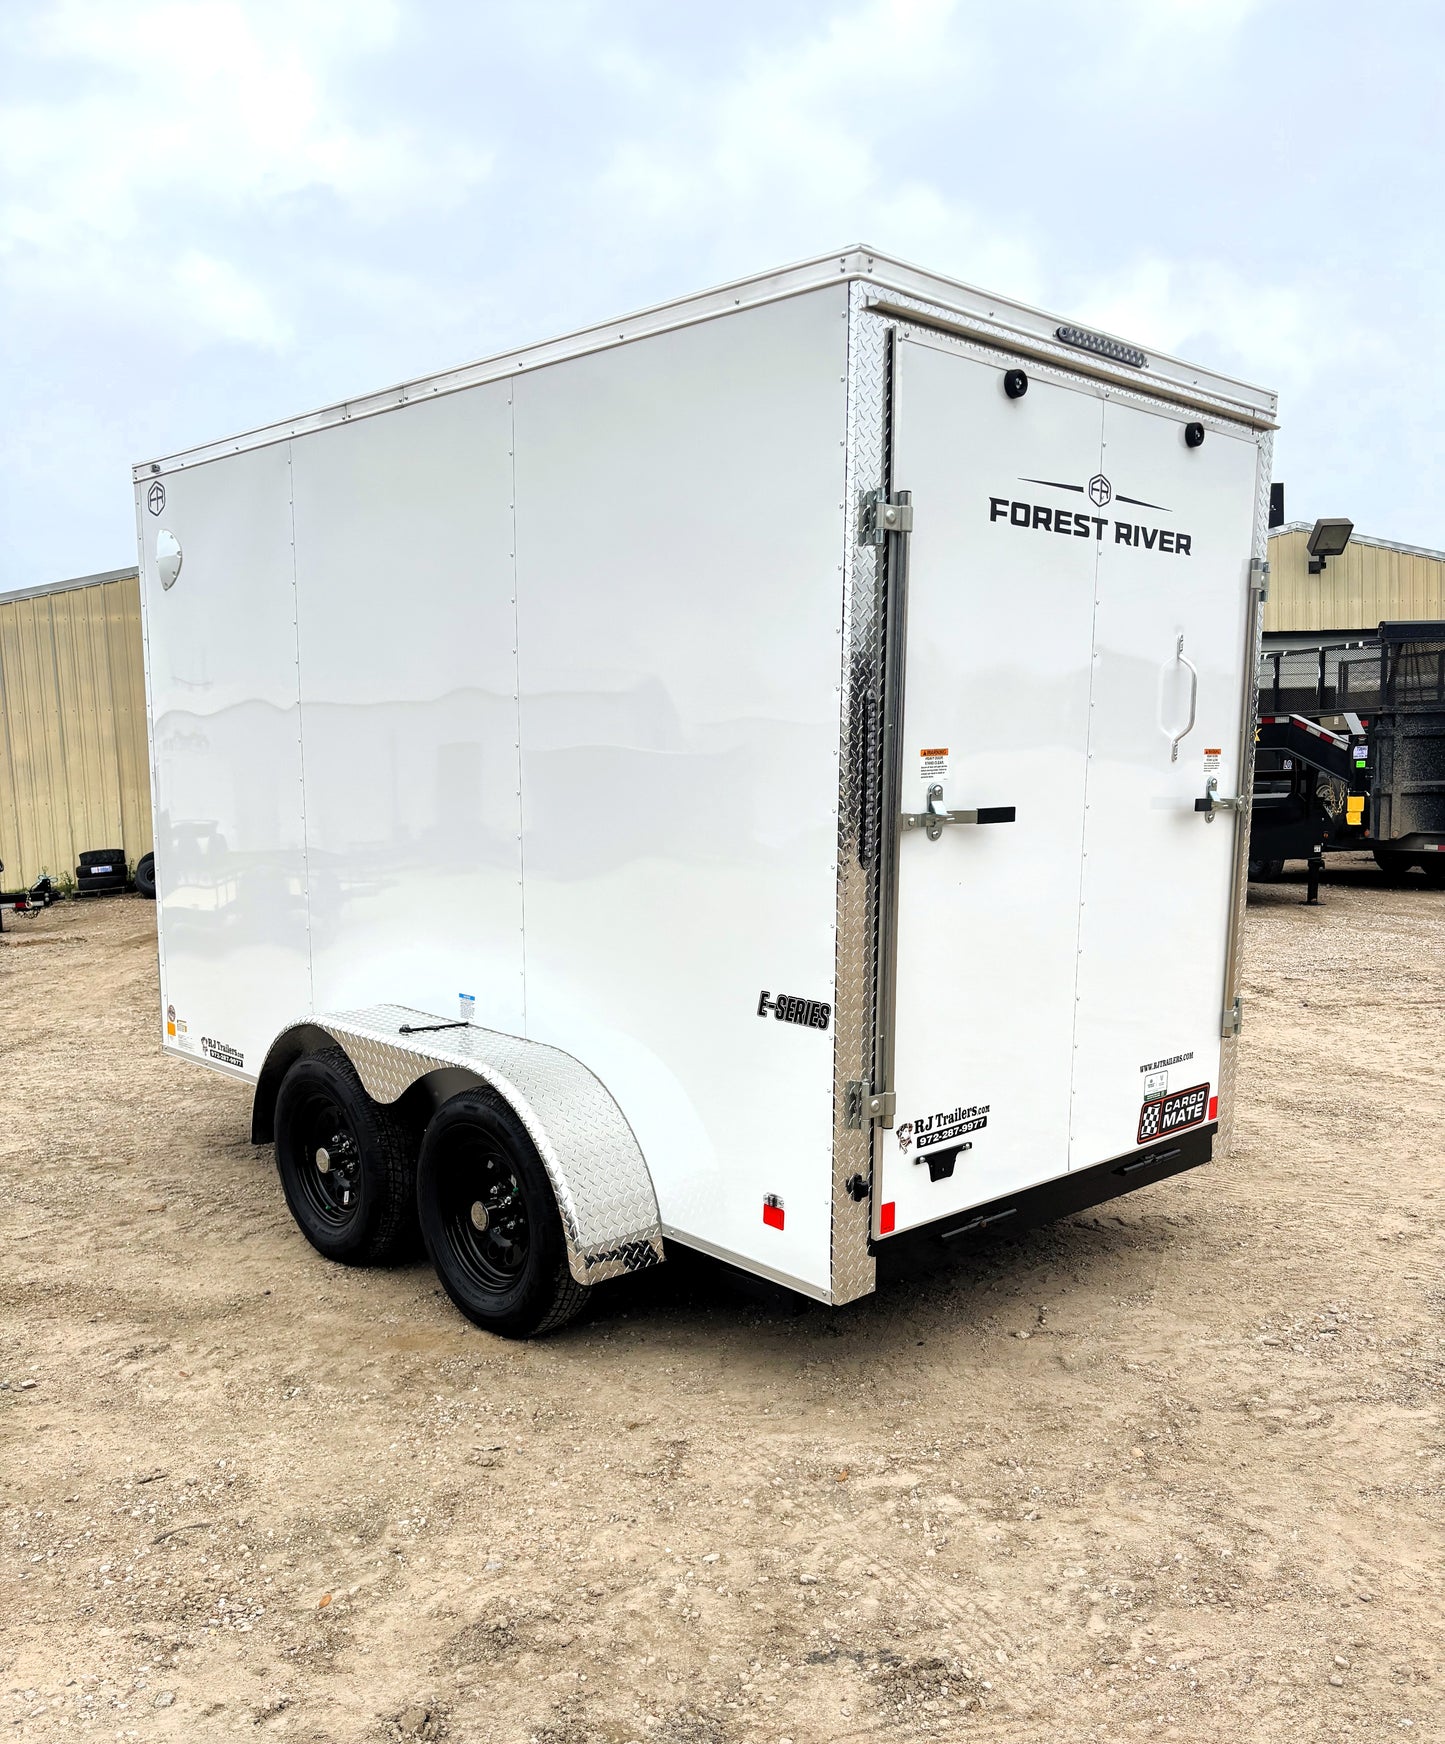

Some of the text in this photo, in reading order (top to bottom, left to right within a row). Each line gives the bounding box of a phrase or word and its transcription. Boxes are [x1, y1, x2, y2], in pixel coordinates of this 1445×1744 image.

[989, 496, 1191, 556] FOREST RIVER
[757, 990, 831, 1031] E-SERIES
[208, 1038, 217, 1049] RJ
[1140, 1051, 1194, 1073] WWW.RJTRAILERS.COM
[1165, 1091, 1205, 1112] CARGO
[914, 1116, 934, 1135] RJ
[1163, 1103, 1203, 1128] MATE
[919, 1119, 985, 1146] 972-287-9977
